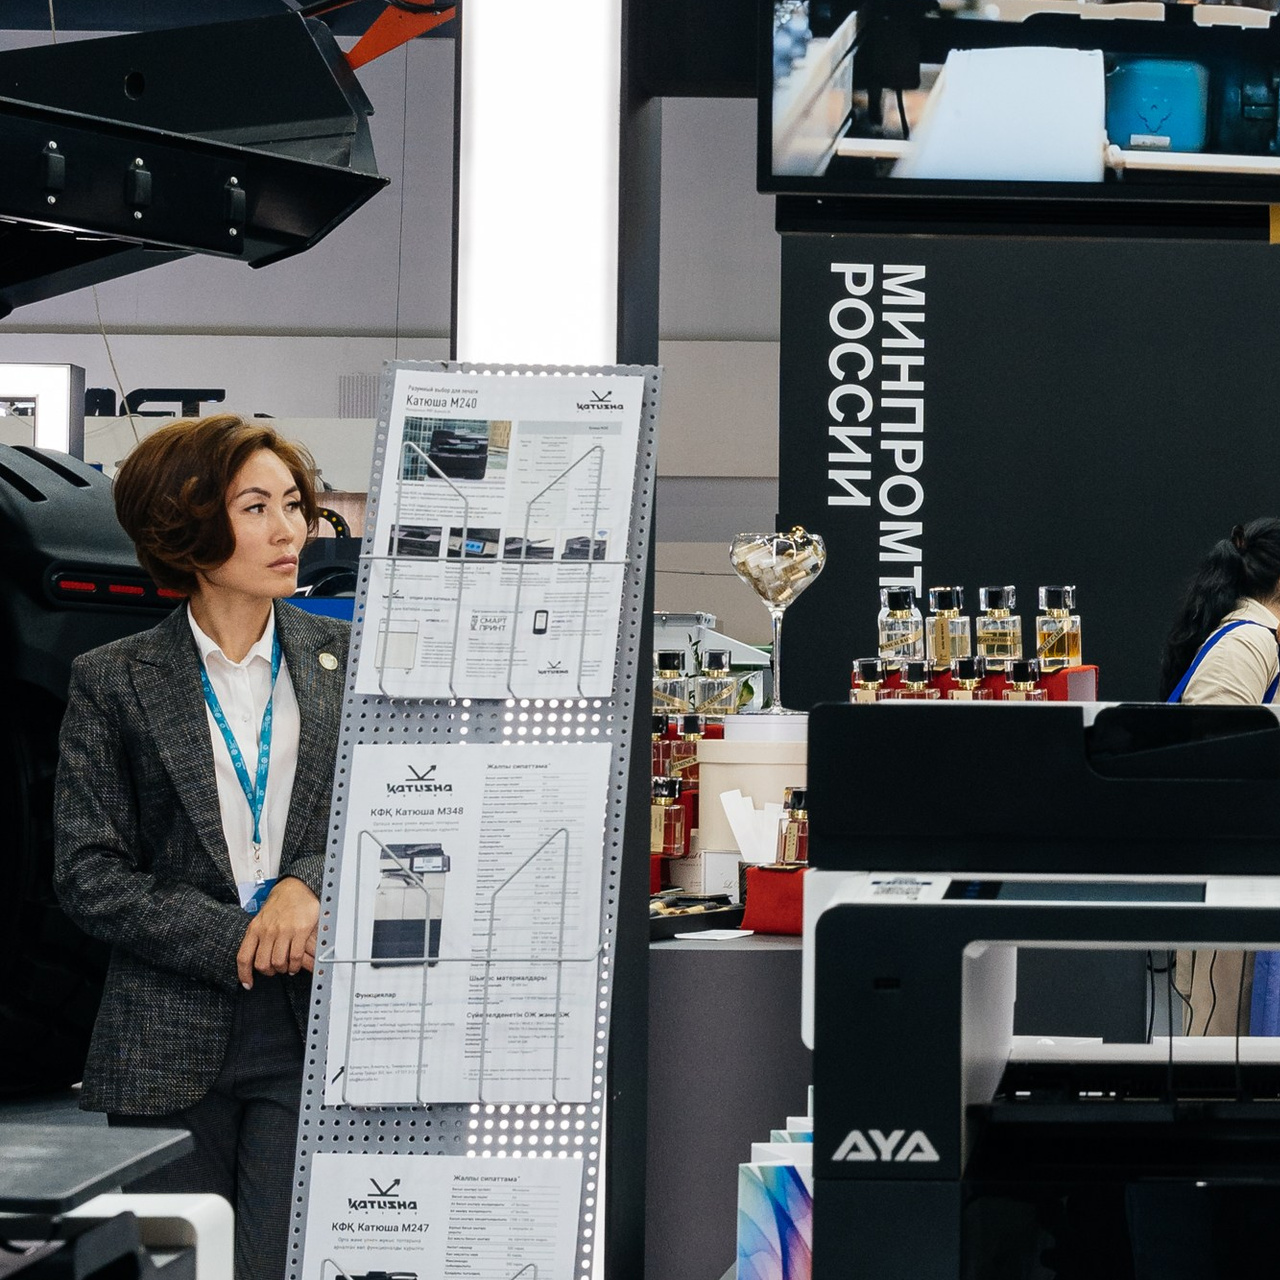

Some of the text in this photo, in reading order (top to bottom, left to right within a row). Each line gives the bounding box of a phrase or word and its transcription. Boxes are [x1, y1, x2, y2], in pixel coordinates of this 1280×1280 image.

[828, 262, 874, 506] РОССИИ
[406, 394, 447, 408] Катюша
[395, 807, 435, 817] Катюша
[831, 1128, 940, 1163] AYA
[331, 1222, 355, 1233] КФҚ
[358, 1222, 398, 1232] Катюша
